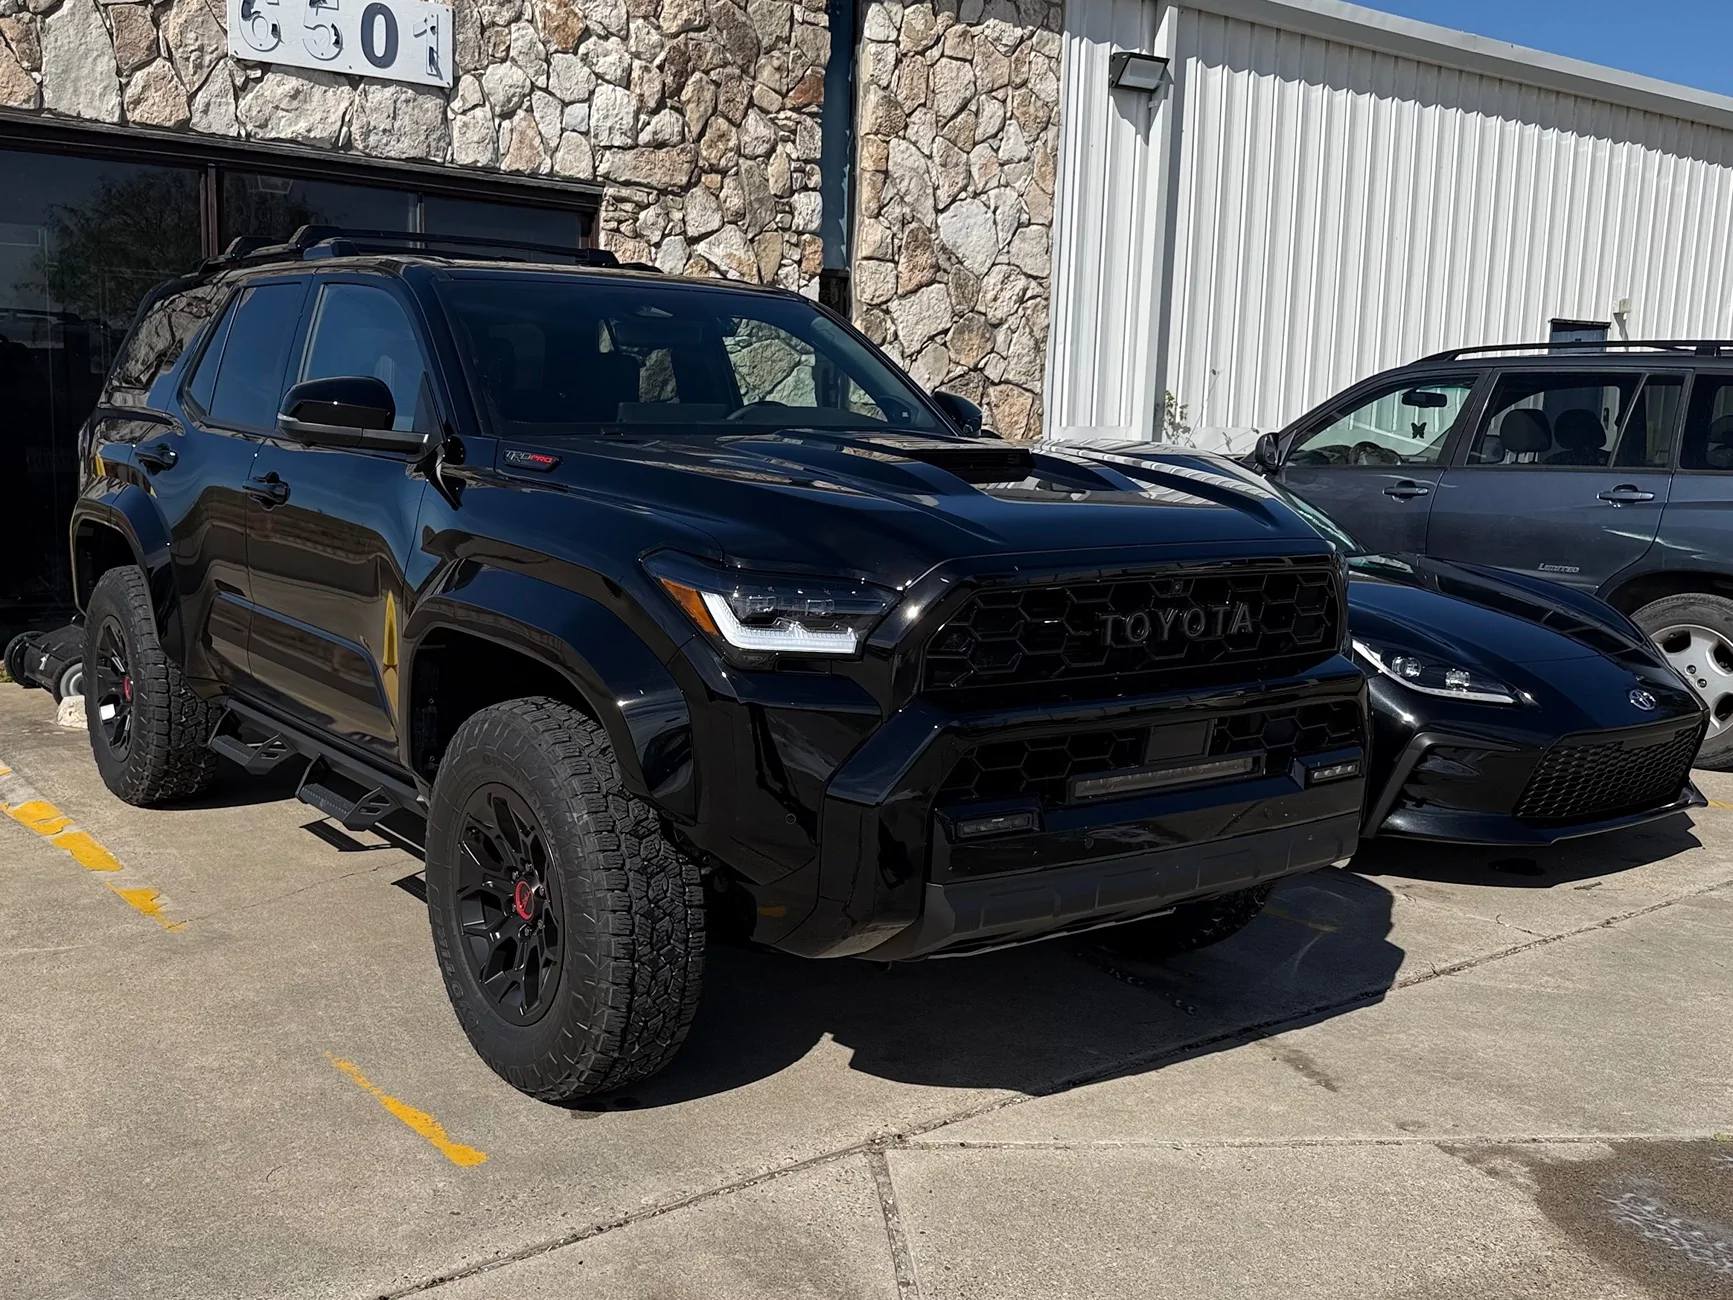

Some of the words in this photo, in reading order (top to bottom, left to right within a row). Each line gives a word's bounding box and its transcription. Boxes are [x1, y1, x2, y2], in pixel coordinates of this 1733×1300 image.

[238, 0, 440, 76] 6501
[504, 449, 531, 462] TRD
[531, 454, 553, 464] PRO
[1099, 600, 1253, 646] TOYOTA
